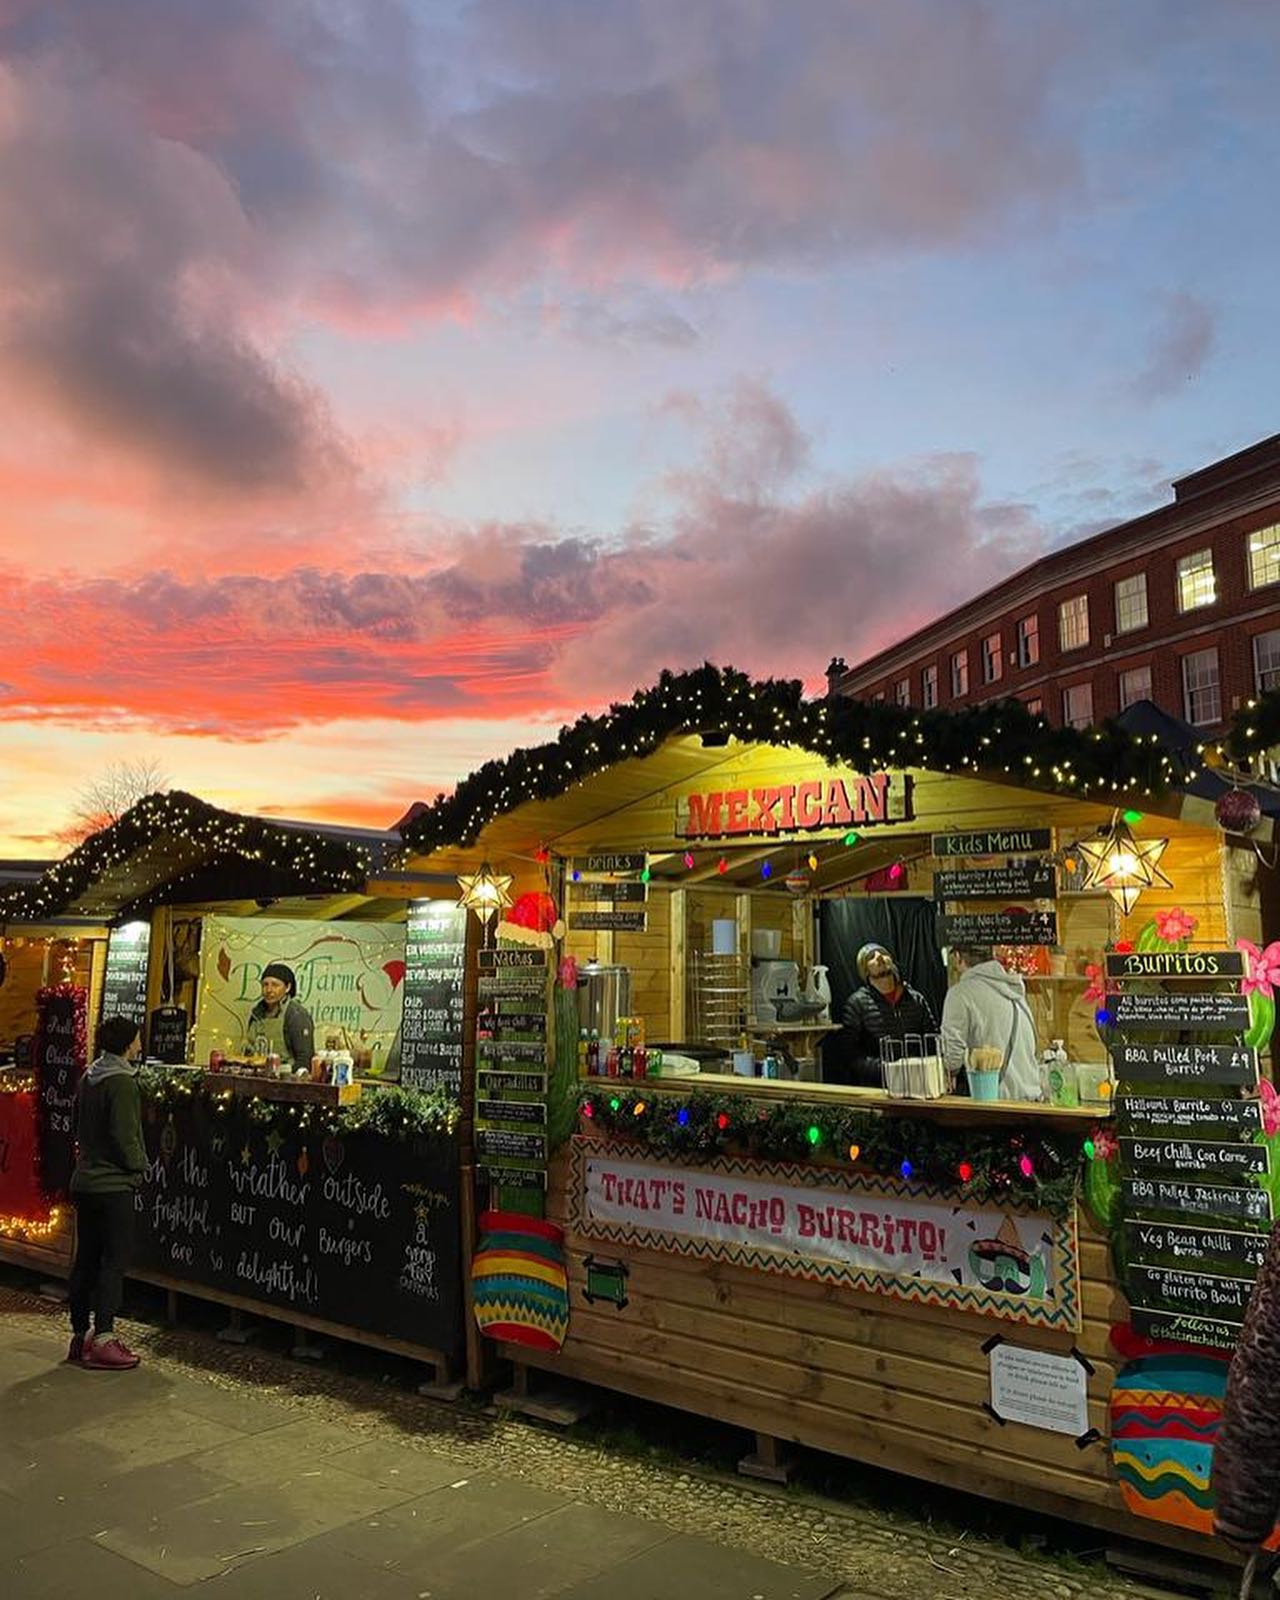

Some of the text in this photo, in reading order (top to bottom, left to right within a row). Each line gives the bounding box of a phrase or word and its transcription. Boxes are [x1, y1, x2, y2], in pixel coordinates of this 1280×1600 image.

[688, 773, 888, 835] MEXICAN
[946, 832, 1033, 854] Kids Menu
[493, 950, 534, 966] Nachos
[1123, 953, 1220, 976] Burritos
[1125, 1047, 1250, 1069] BBQ Pulled Pork £9
[1164, 1063, 1206, 1076] Burrito
[1174, 1099, 1211, 1113] Burrito
[1242, 1105, 1258, 1119] £9
[1133, 1142, 1264, 1172] Beef Chilli Con Carne £8
[177, 1144, 208, 1188] the
[228, 1156, 311, 1205] weather
[1132, 1182, 1155, 1197] BBQ
[1159, 1184, 1191, 1199] Pulled
[134, 1189, 145, 1212] is
[231, 1202, 257, 1226] BUT
[319, 1227, 372, 1267] Burgers
[601, 1172, 948, 1262] THAT'S NACHO BURRITO!
[1139, 1228, 1163, 1249] Veg
[1167, 1230, 1197, 1247] Bean
[1201, 1233, 1232, 1251] Chilli
[171, 1242, 194, 1266] are
[210, 1249, 223, 1270] so
[1245, 1251, 1265, 1266] £8
[1147, 1269, 1161, 1281] Go
[1164, 1271, 1196, 1287] gluten
[1161, 1283, 1243, 1306] Burrito Bowl
